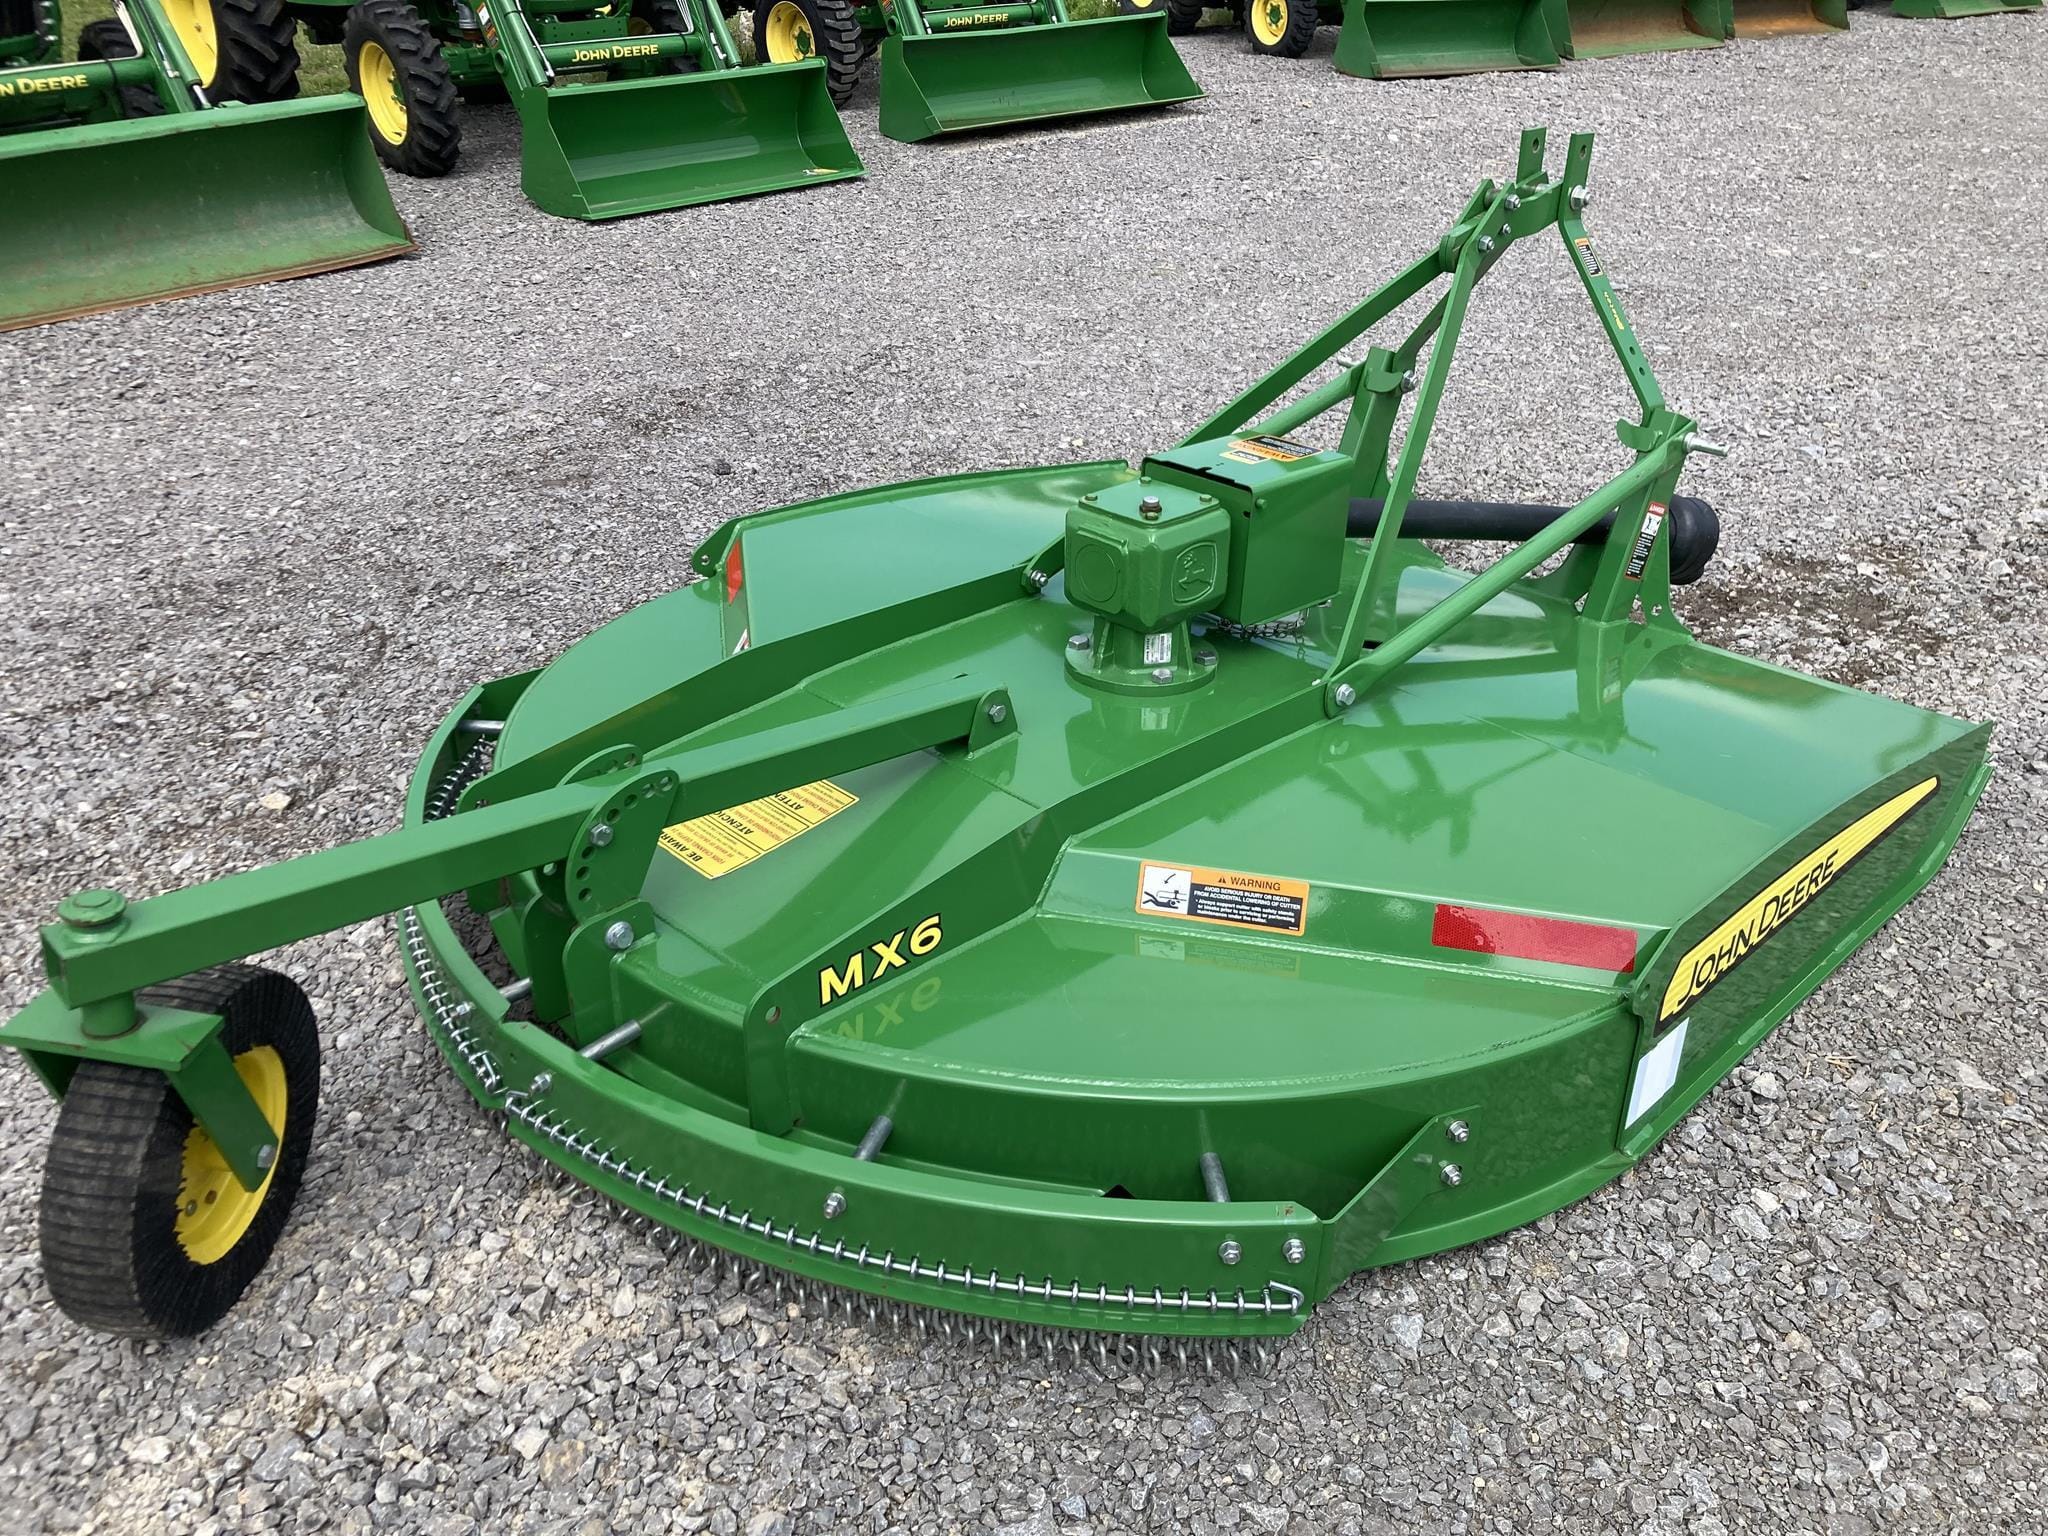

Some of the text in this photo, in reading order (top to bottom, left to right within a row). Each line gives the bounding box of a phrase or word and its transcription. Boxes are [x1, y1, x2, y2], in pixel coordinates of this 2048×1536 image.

[944, 13, 1009, 28] JOHN DEERE
[572, 44, 659, 62] JOHN DEERE
[16, 74, 89, 94] DEERE
[686, 851, 703, 862] BE
[1231, 876, 1280, 891] WARNING
[1677, 848, 1839, 1006] JOHN DEERE
[820, 914, 943, 1006] MX6
